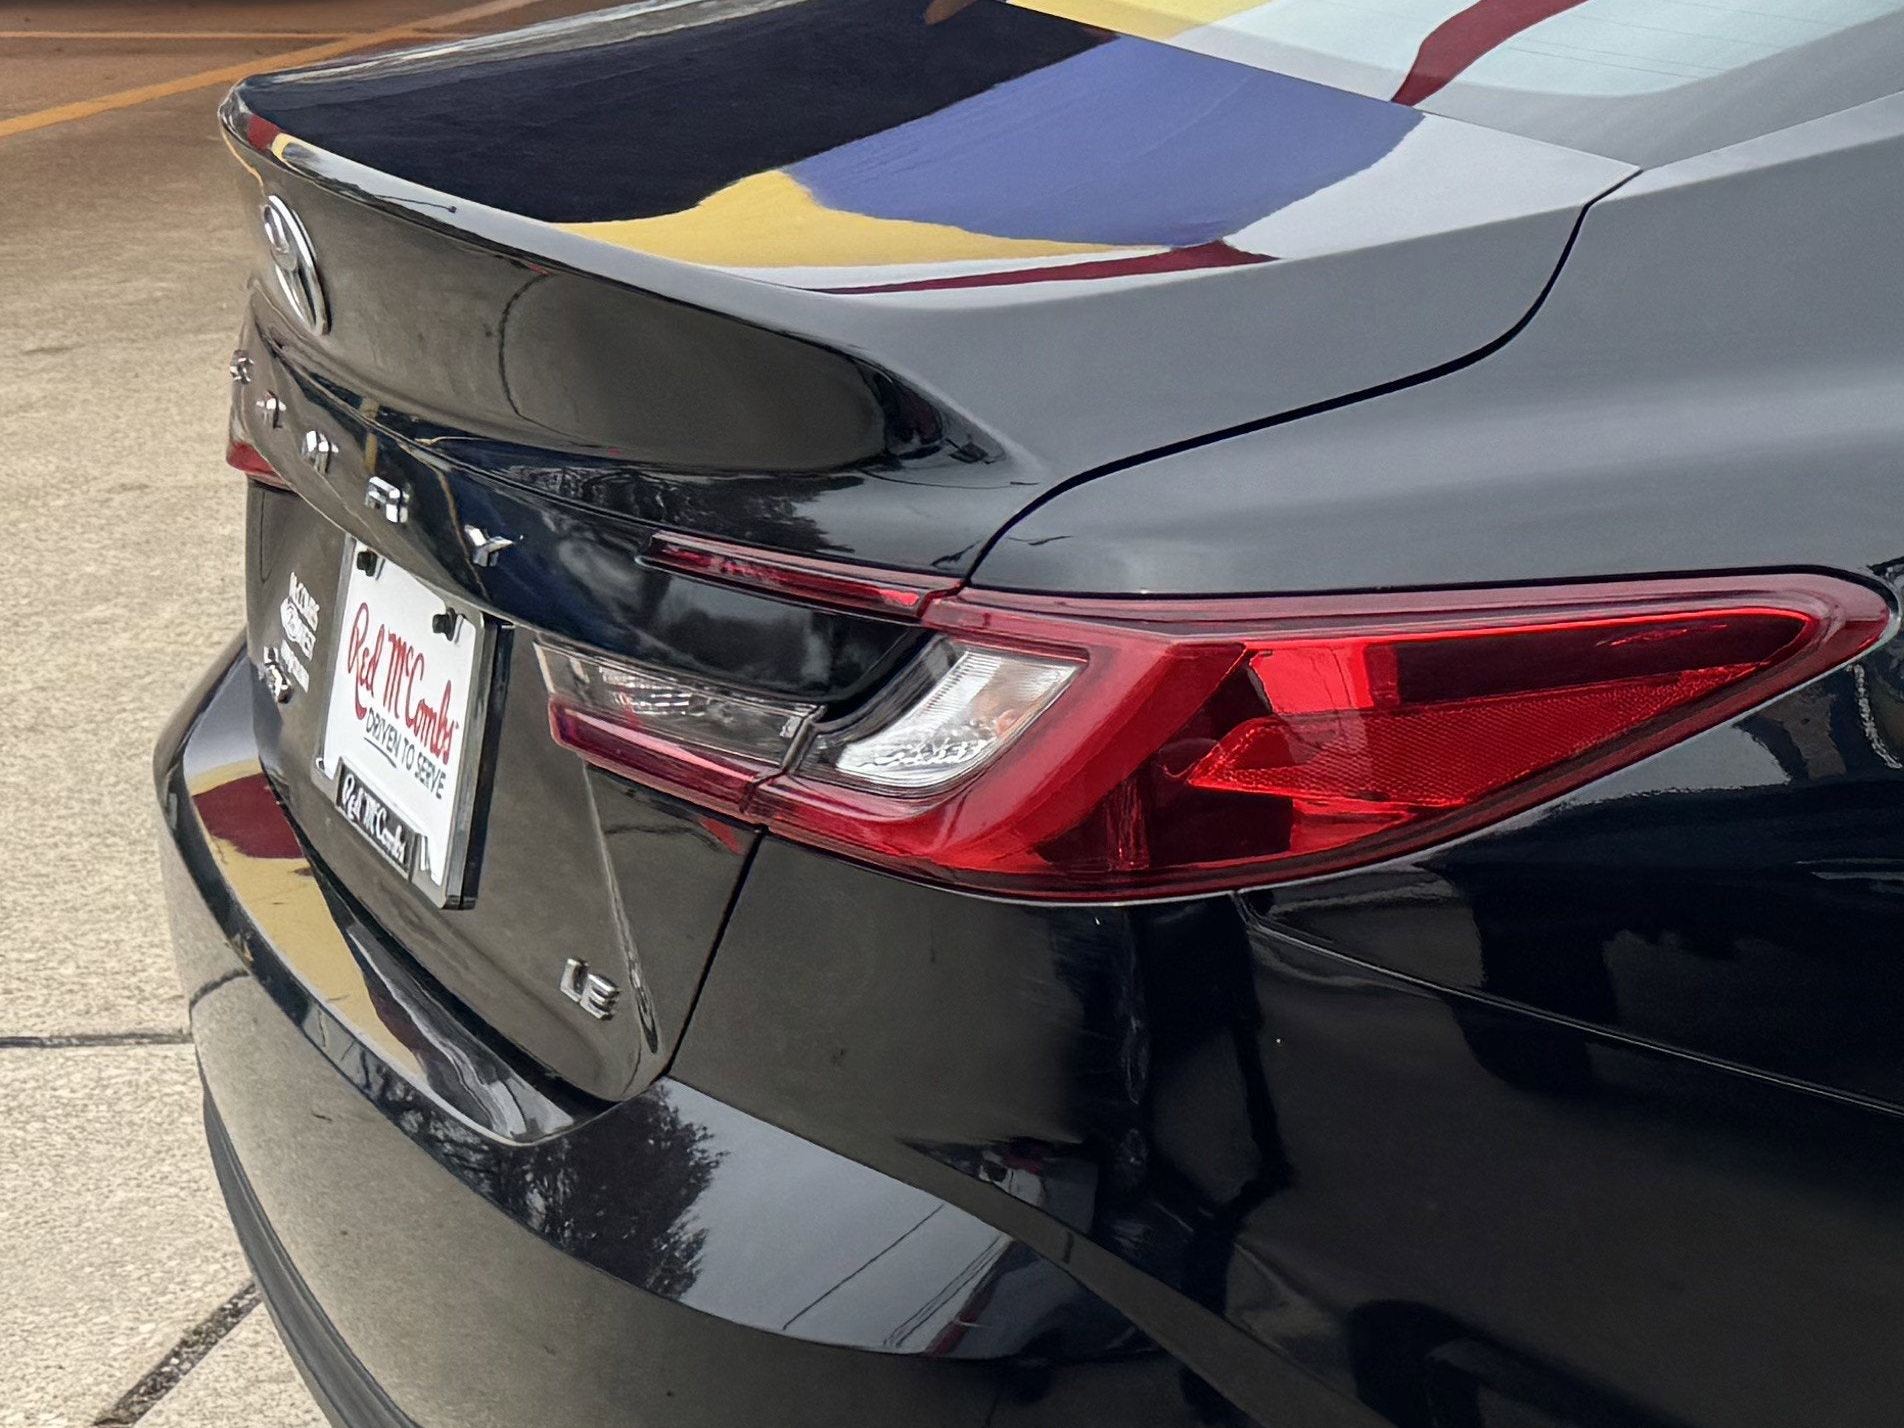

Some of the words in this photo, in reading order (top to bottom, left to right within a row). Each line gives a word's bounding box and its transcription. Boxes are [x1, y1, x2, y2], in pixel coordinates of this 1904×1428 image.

[348, 601, 385, 721] Red
[365, 707, 402, 758] DRIVEN
[401, 736, 416, 771] TO
[414, 752, 446, 800] SERVE
[560, 958, 618, 1021] LE
